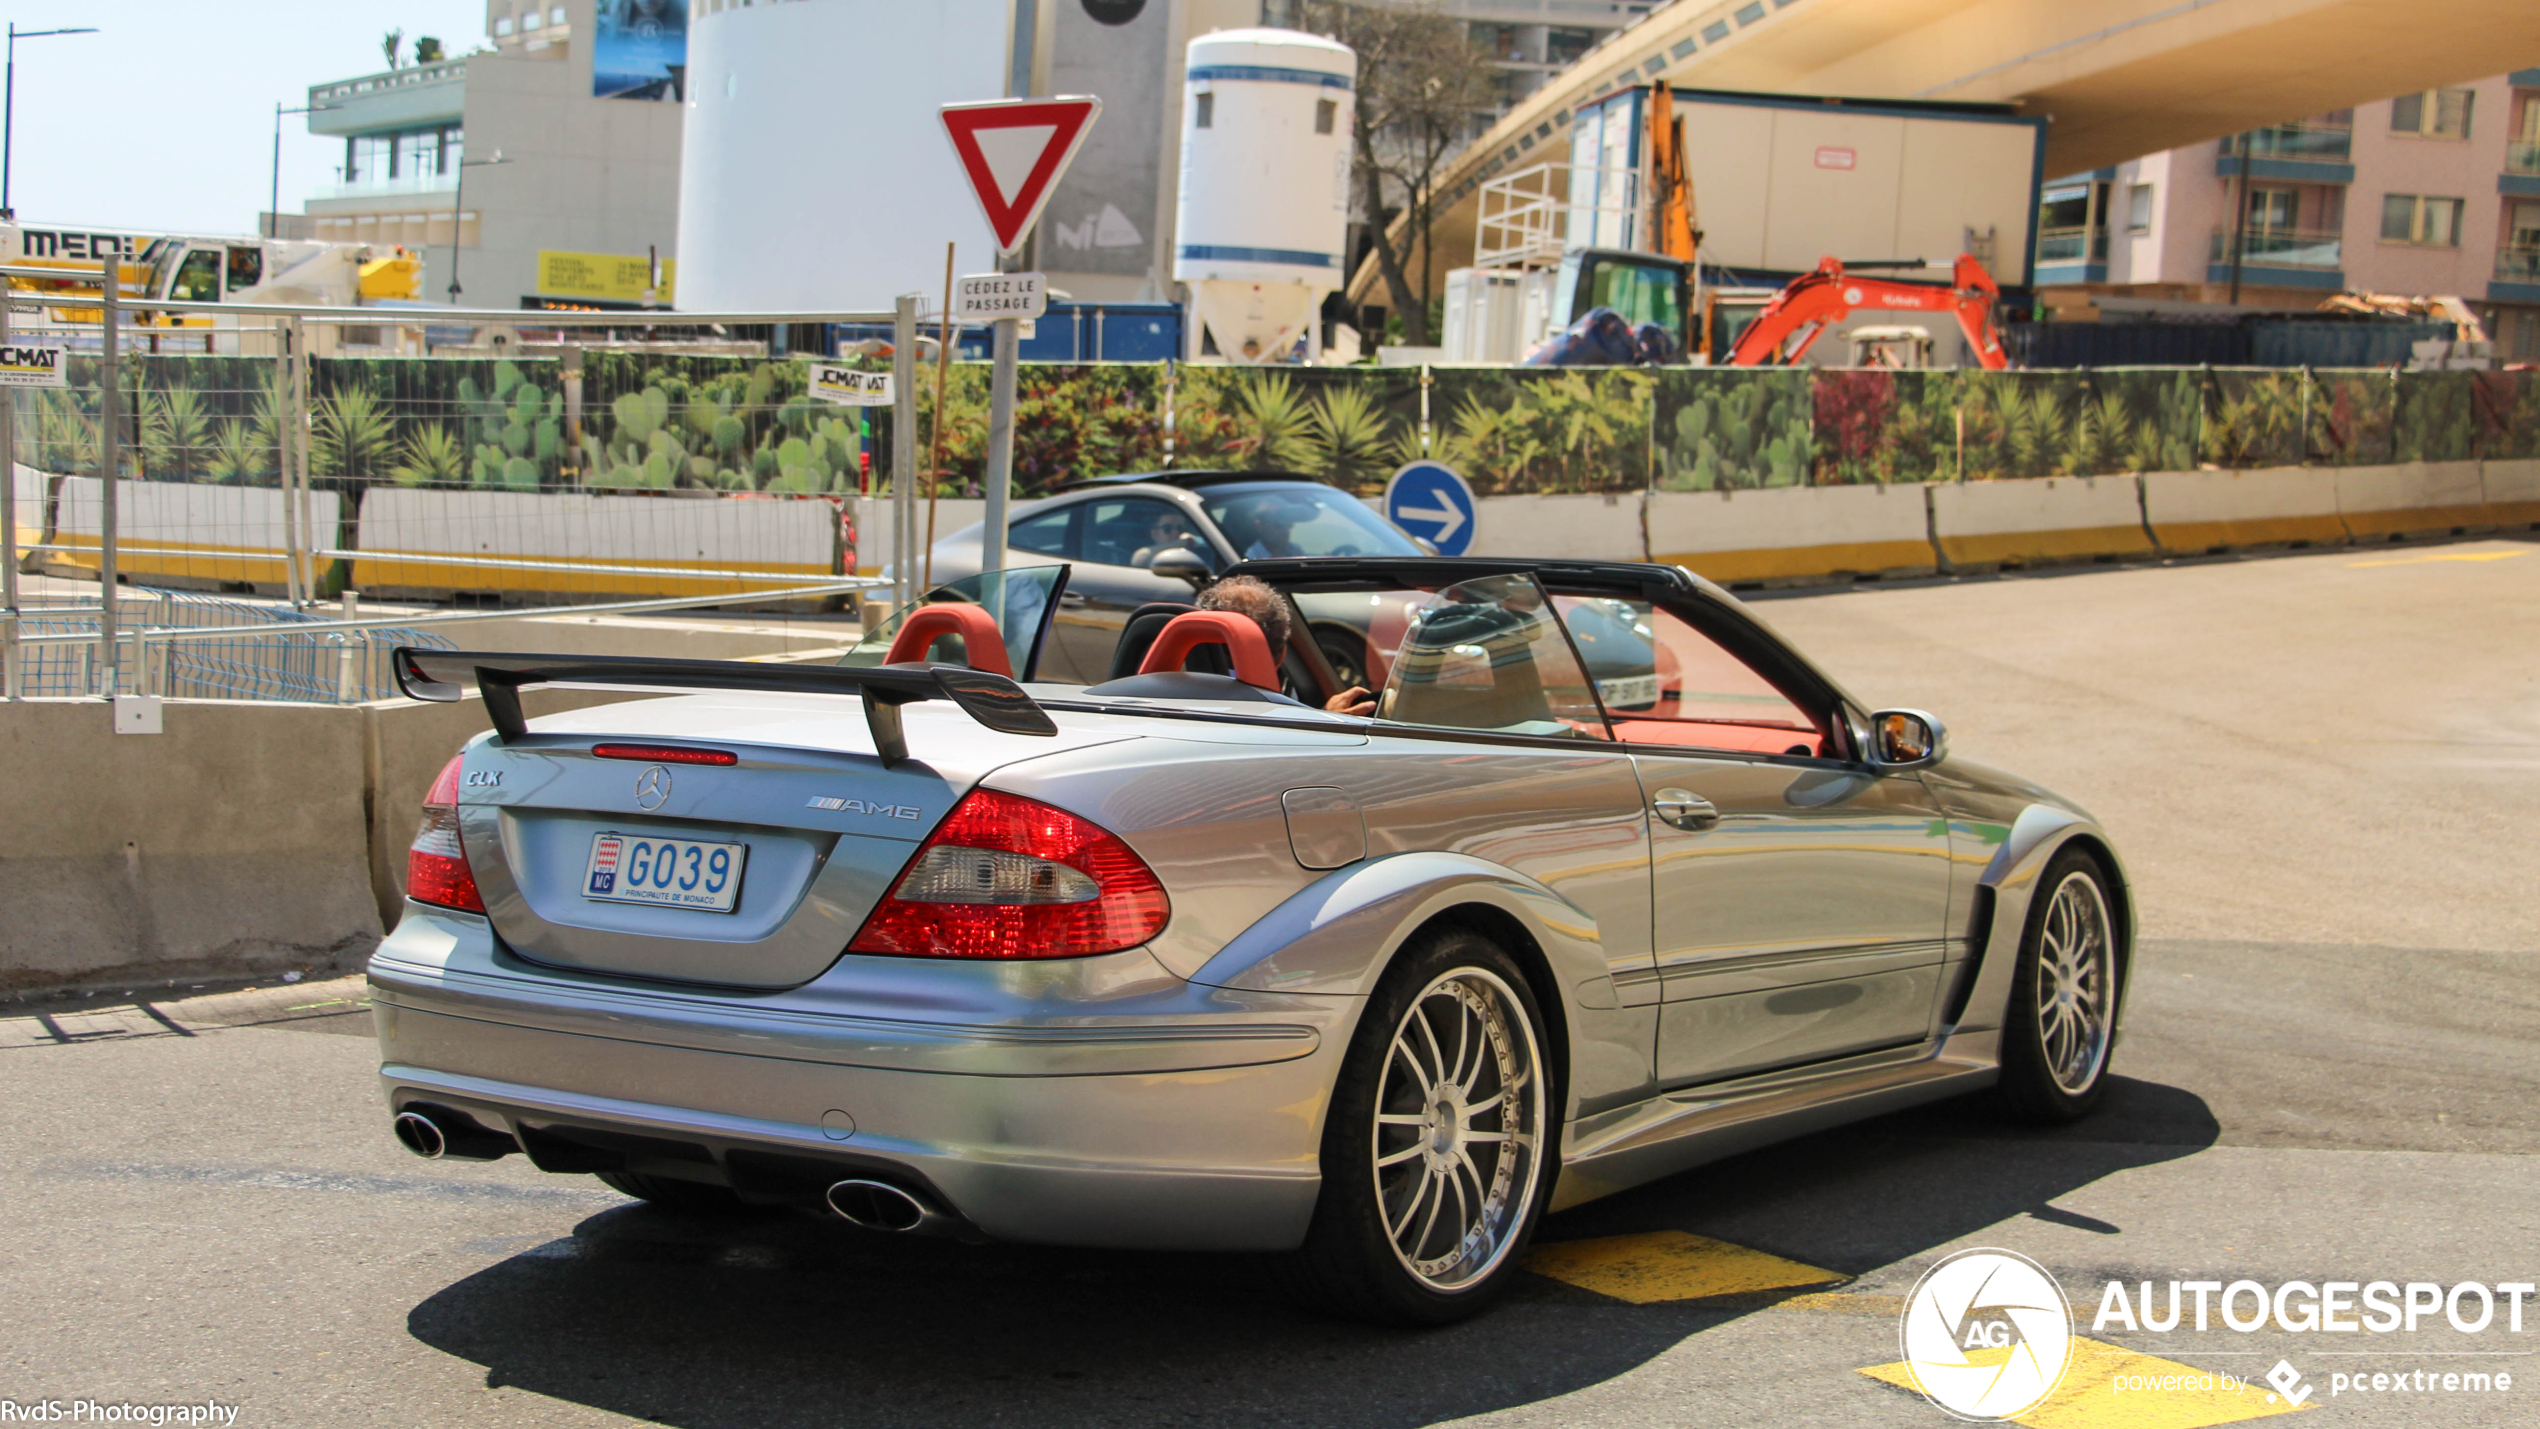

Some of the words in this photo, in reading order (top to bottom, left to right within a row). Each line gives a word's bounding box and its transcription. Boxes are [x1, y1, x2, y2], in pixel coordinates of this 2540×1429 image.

[965, 280, 1010, 295] CÉDEZ
[1018, 280, 1034, 292] LE
[966, 297, 1030, 311] PASSAGE
[818, 370, 863, 388] JCMAT
[466, 771, 503, 787] CLK
[839, 799, 921, 821] AMG
[628, 841, 730, 893] G039
[594, 874, 611, 889] MC
[625, 889, 670, 901] PRINCIPAUTE
[672, 893, 681, 902] DE
[683, 895, 715, 905] MONACO
